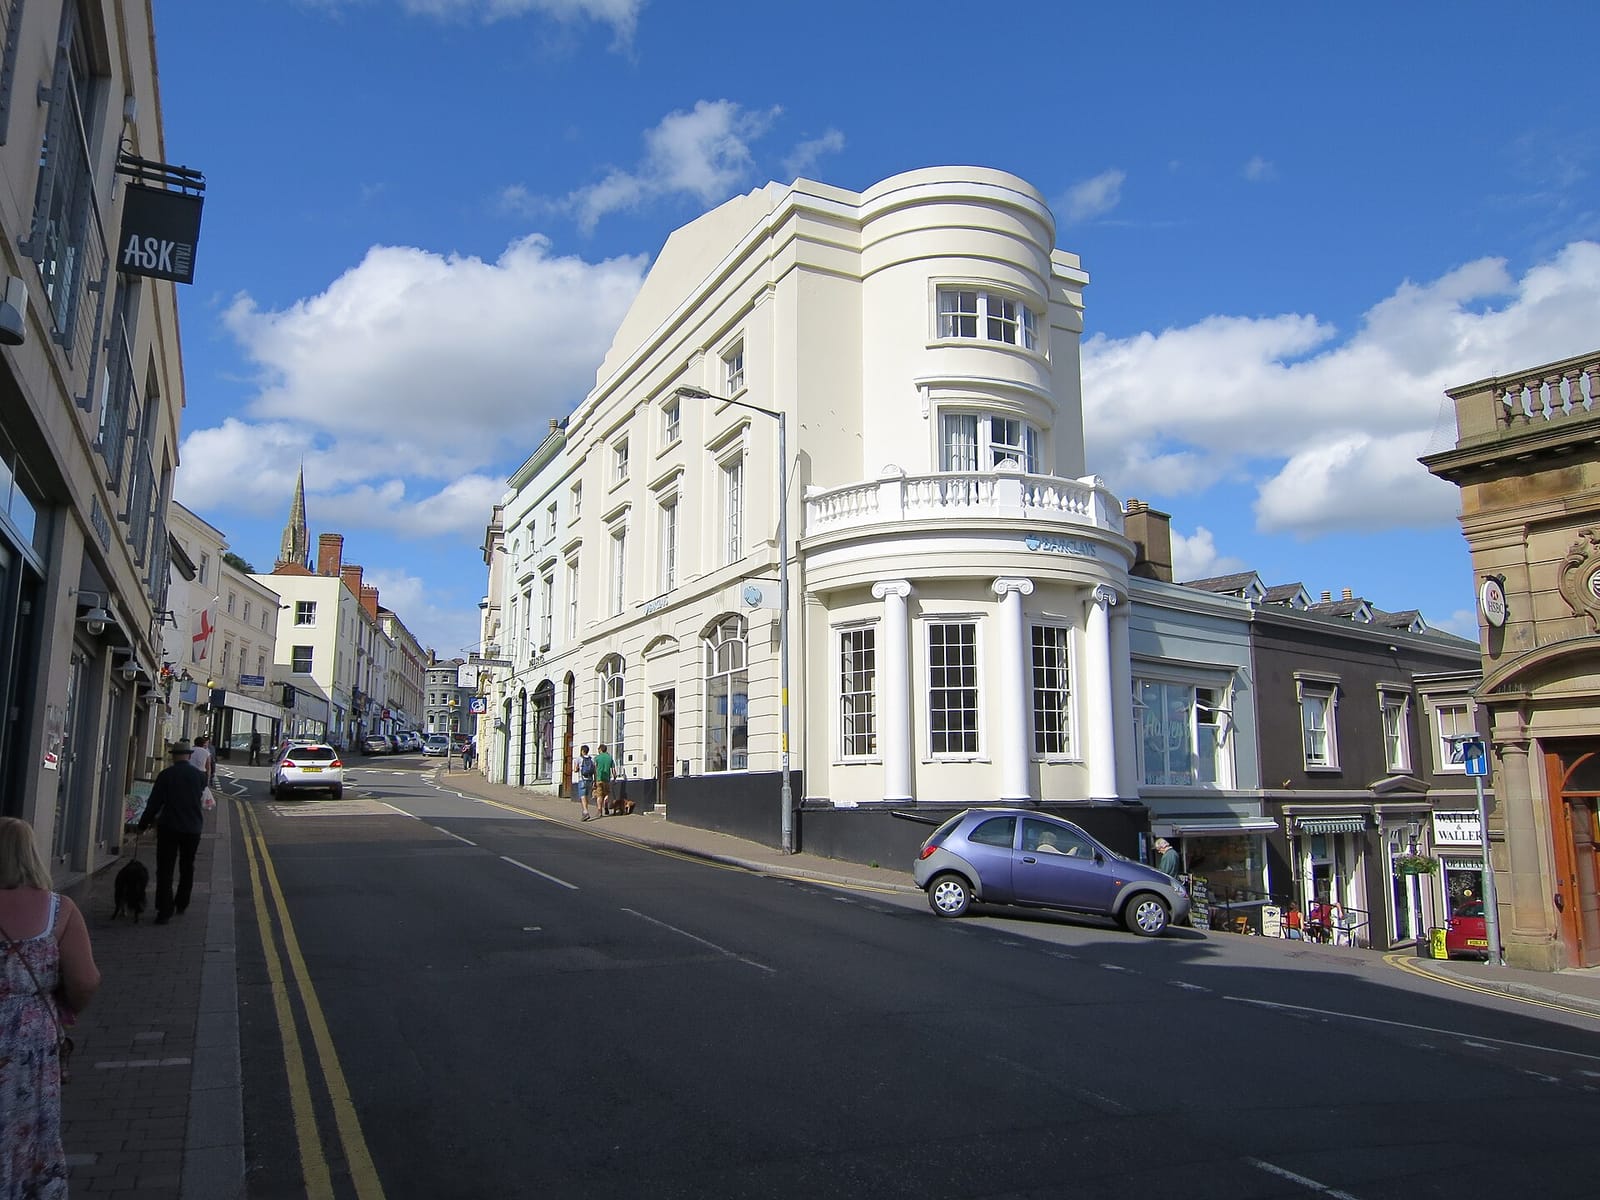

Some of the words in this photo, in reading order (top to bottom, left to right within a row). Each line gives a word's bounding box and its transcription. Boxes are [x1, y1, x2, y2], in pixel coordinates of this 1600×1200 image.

[124, 234, 175, 273] ASK
[1040, 537, 1097, 557] BARCLAYS
[1488, 601, 1504, 614] HSBC
[1437, 813, 1481, 823] WALLER
[1438, 830, 1482, 841] WALLER
